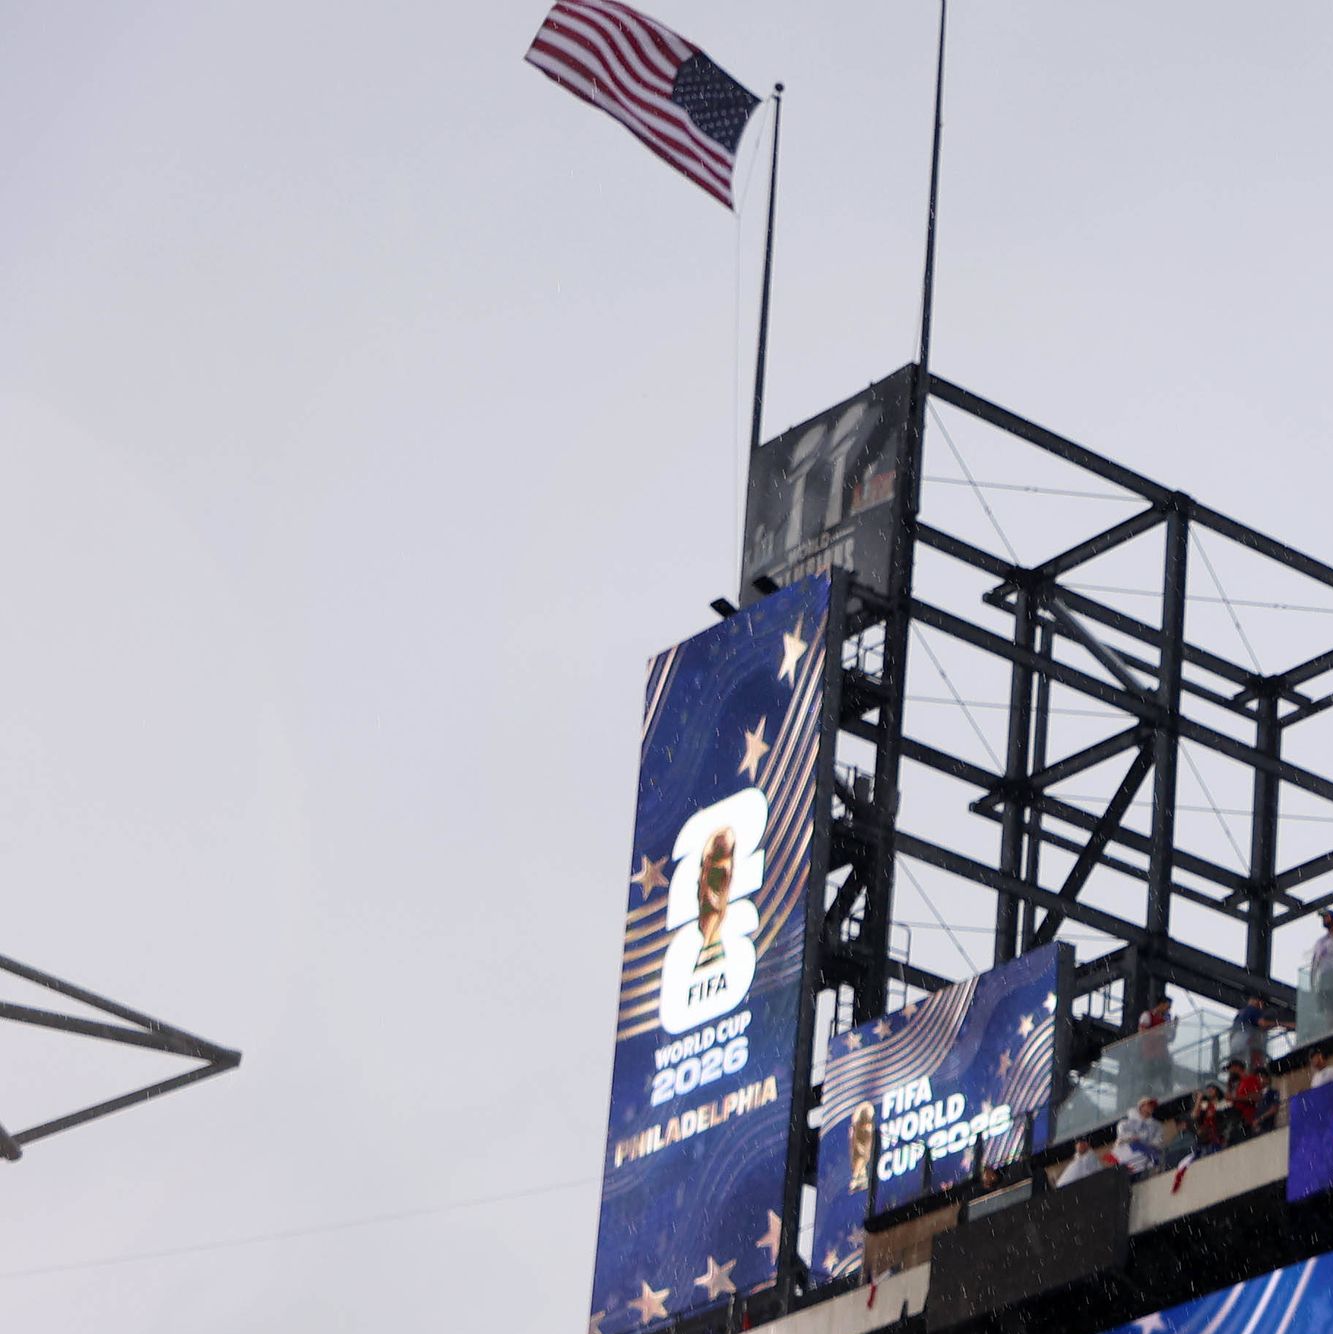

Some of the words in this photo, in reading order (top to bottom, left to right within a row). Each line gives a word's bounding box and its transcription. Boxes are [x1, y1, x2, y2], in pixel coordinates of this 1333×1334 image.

[687, 972, 728, 1007] FIFA
[654, 1026, 716, 1071] WORLD
[715, 1010, 752, 1043] CUP
[651, 1036, 749, 1107] 2026
[881, 1075, 932, 1120] FIFA
[613, 1074, 778, 1169] PHILADELPHIA
[880, 1092, 966, 1150] WORLD
[877, 1140, 926, 1182] CUP
